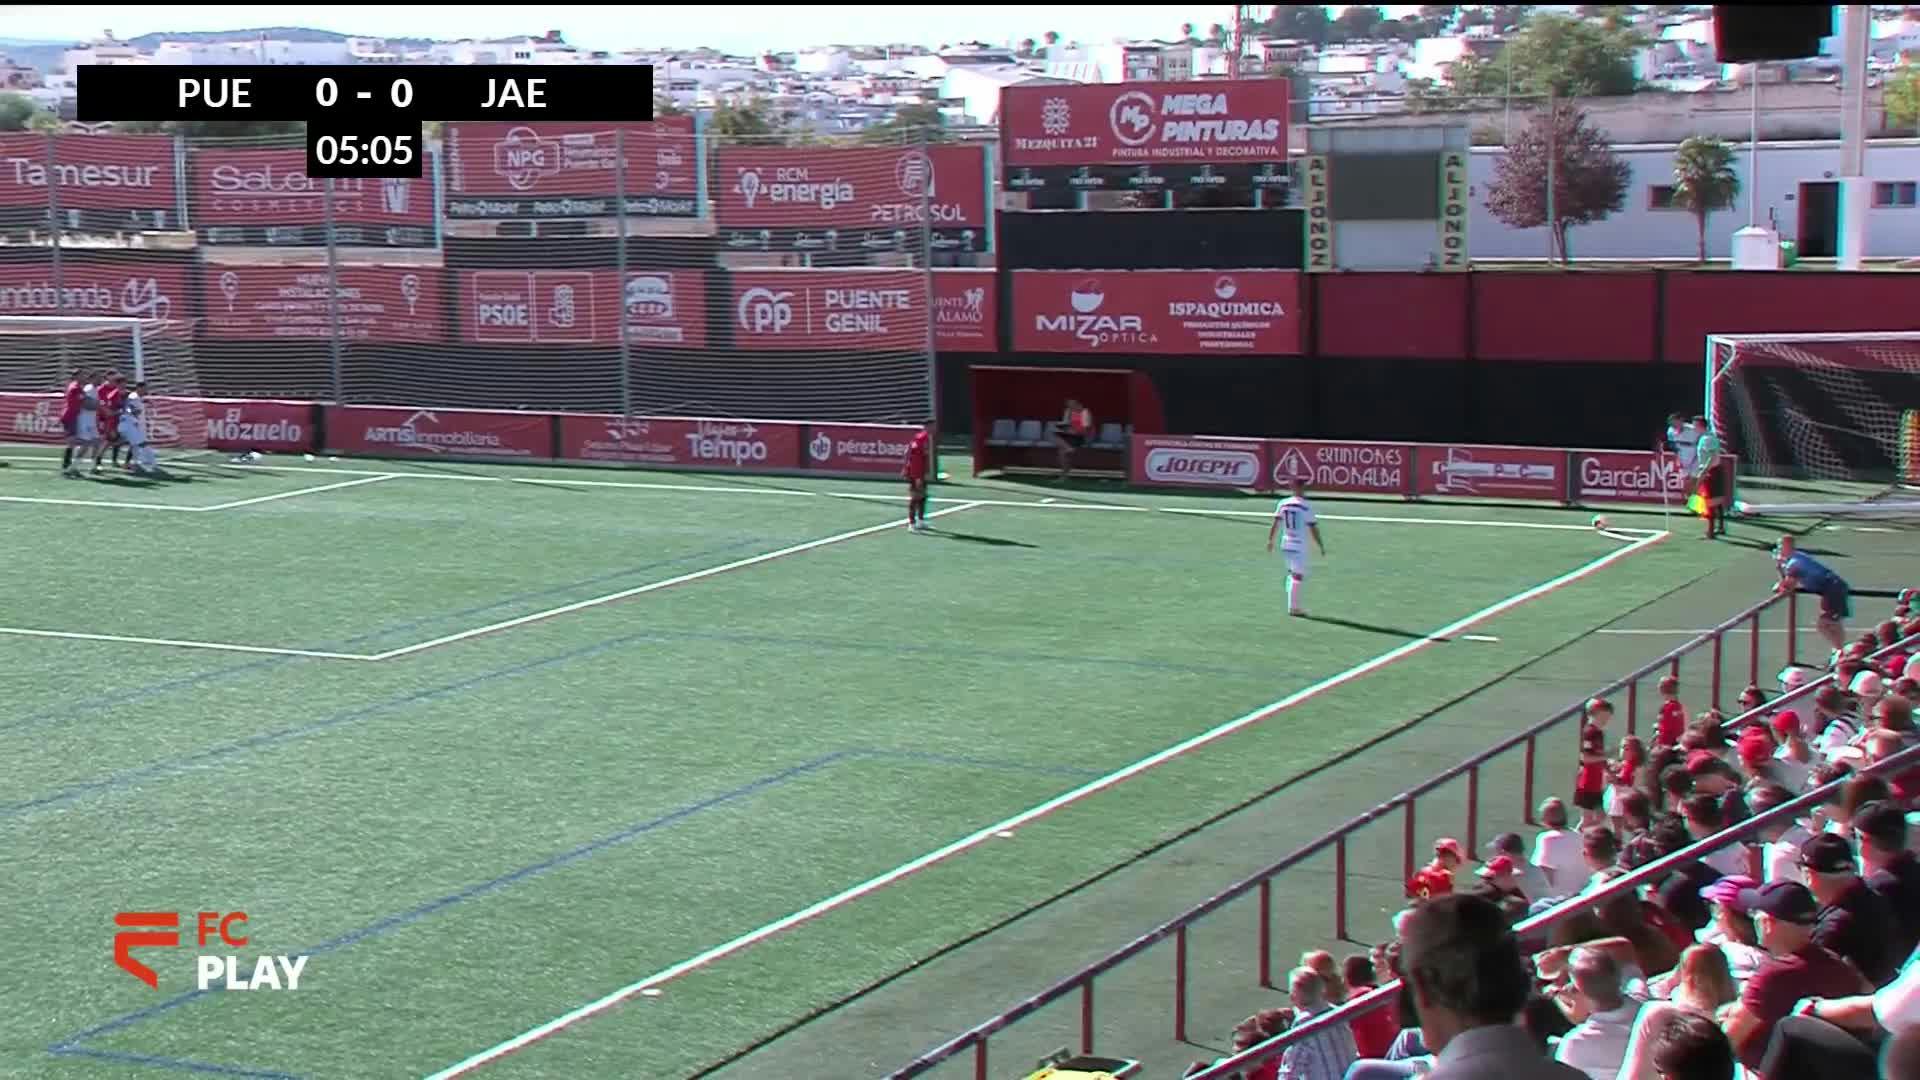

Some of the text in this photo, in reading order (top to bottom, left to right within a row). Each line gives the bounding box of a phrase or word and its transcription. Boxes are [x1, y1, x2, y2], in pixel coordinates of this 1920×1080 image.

[1162, 93, 1227, 115] MEGA
[1162, 119, 1280, 142] PINTURAS
[1015, 138, 1080, 151] MEZQUITA
[1112, 148, 1149, 157] PINTURA
[1152, 148, 1204, 157] INDUSTRIAL
[1216, 146, 1279, 156] DECORATIVA
[507, 150, 545, 167] NPG
[8, 157, 159, 187] Tamesur
[777, 168, 808, 181] RCM
[769, 177, 854, 210] energía
[871, 203, 967, 222] PETROSOL
[824, 289, 912, 309] PUENTE
[479, 303, 529, 326] PSOE
[1168, 302, 1285, 318] ISPAQUIMICA
[825, 313, 888, 333] GENIL
[1035, 315, 1143, 347] MIZAR
[1100, 332, 1159, 344] OPTICA
[206, 417, 302, 442] Mozuelo
[685, 433, 768, 465] Tempo
[1316, 447, 1401, 464] EXTINTORES
[1156, 456, 1250, 477] JOSEPH
[1317, 466, 1401, 487] MORALBA
